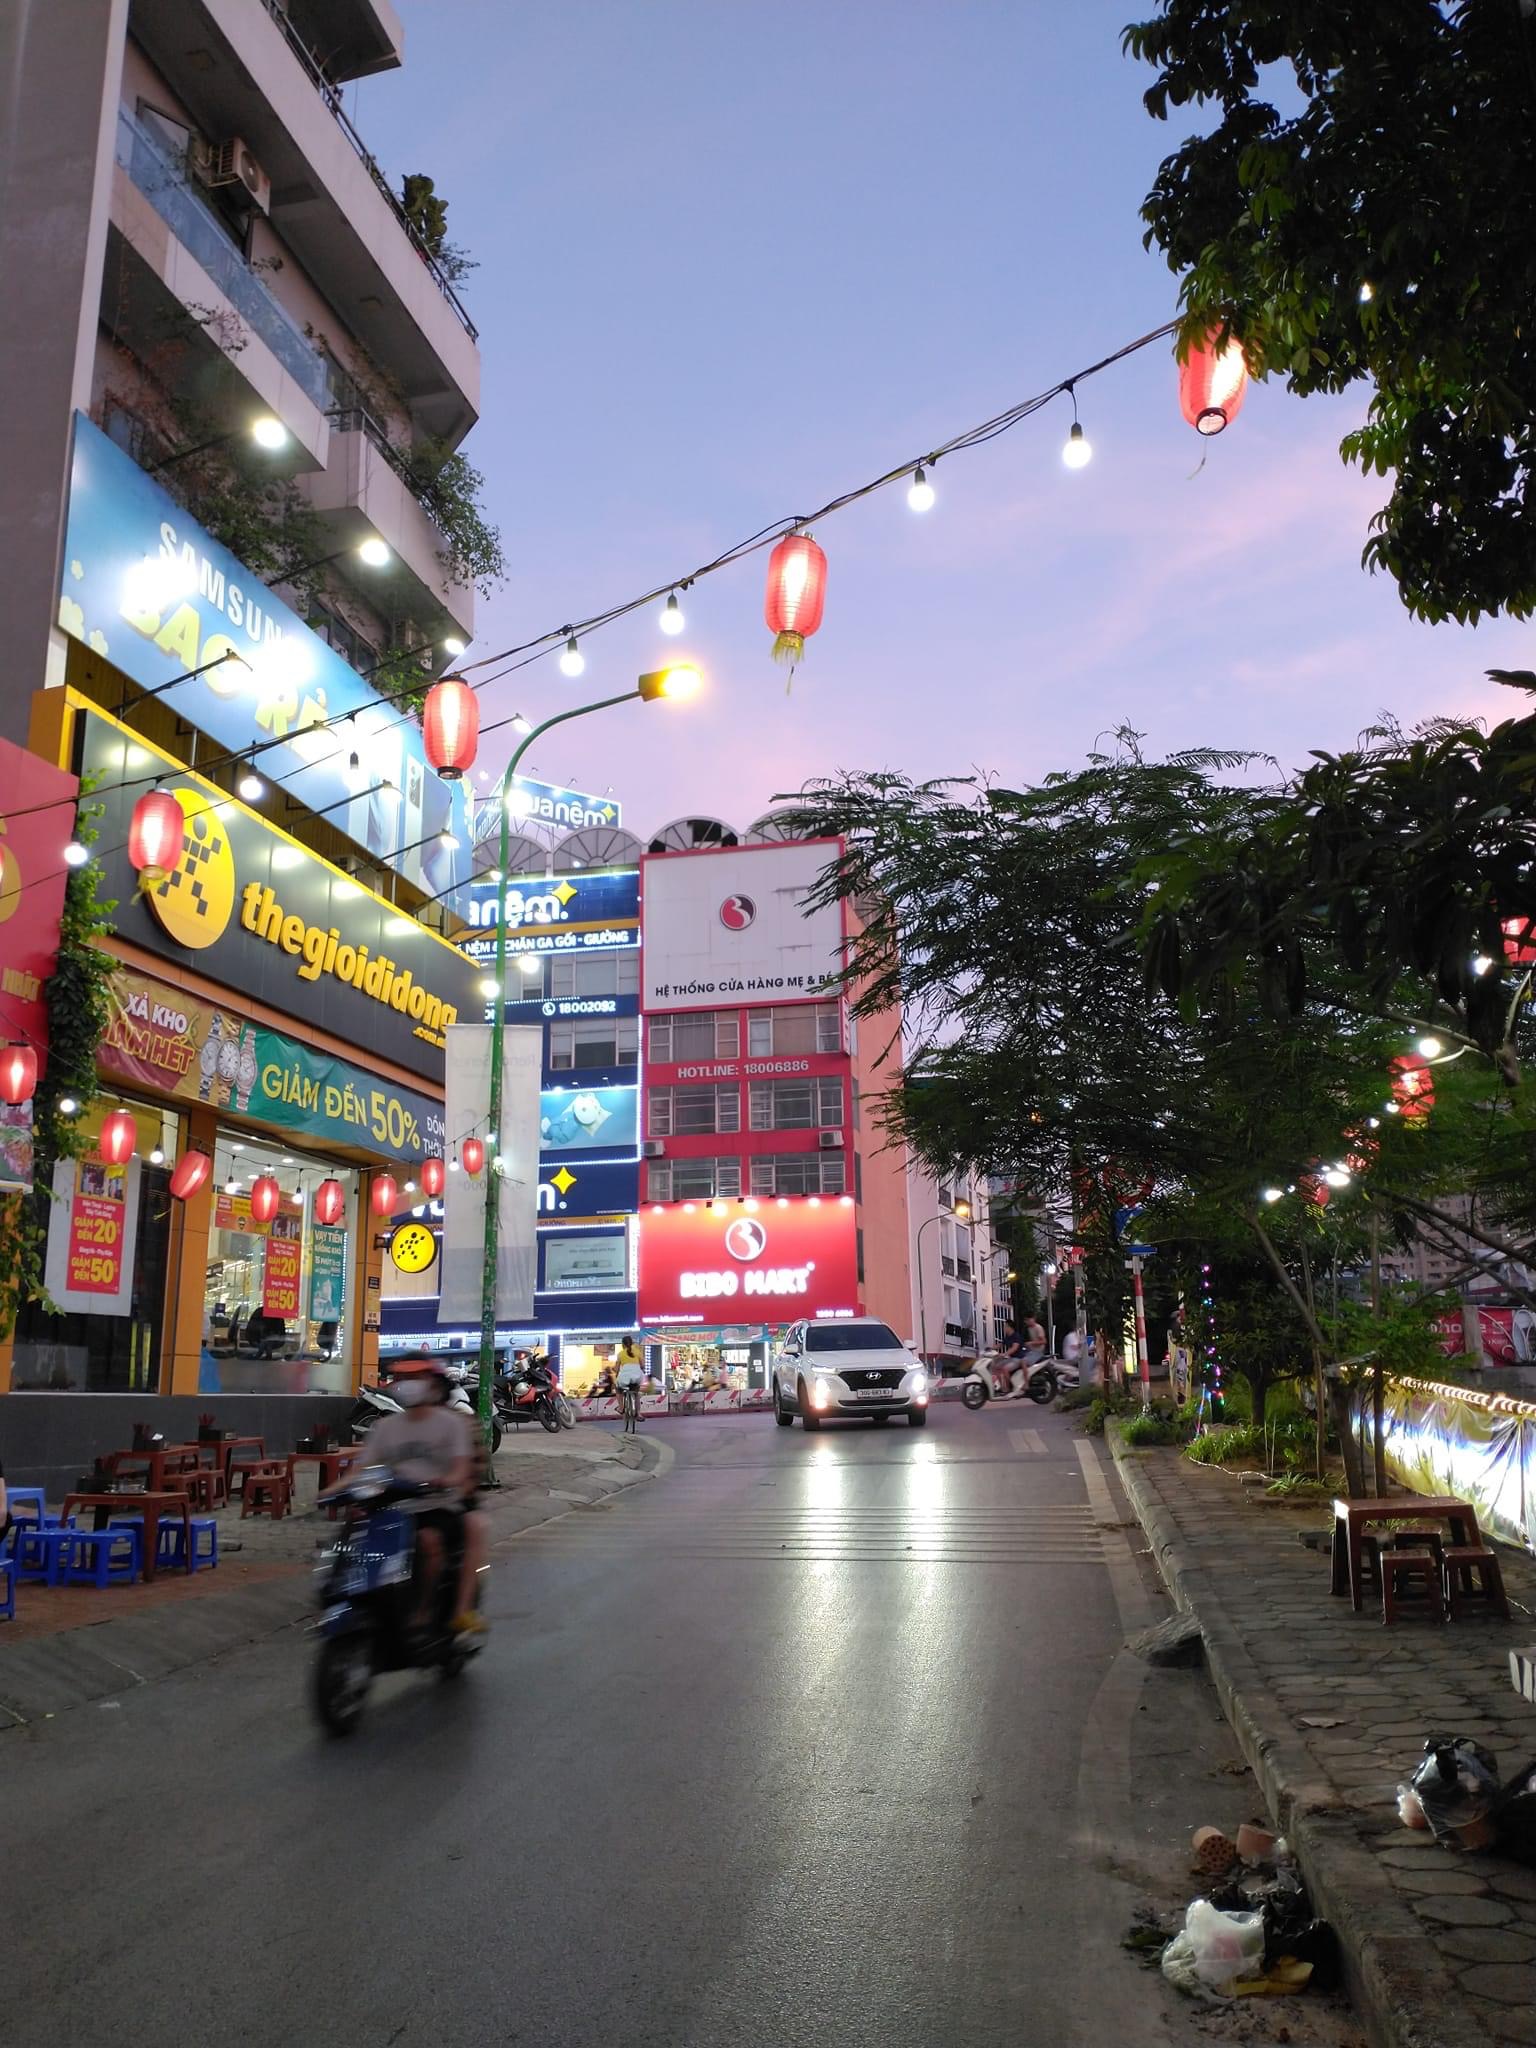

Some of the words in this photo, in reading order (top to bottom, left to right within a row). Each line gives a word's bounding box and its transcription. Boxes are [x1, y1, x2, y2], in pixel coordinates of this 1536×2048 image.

[157, 522, 296, 662] SAMSUN
[241, 881, 458, 1035] thegioididong
[537, 937, 554, 949] GA
[655, 985, 669, 998] HỆ
[673, 980, 715, 995] THỐNG
[719, 977, 744, 992] CỬA
[747, 975, 784, 990] HÀNG
[788, 974, 803, 988] MẸ
[807, 974, 815, 984] &
[125, 991, 148, 1020] XẢ
[152, 1004, 187, 1034] KHO
[559, 1001, 616, 1015] 18002092
[151, 1032, 195, 1075] HẾT
[678, 1065, 739, 1079] HOTLINE:
[744, 1060, 809, 1075] 18006886
[262, 1063, 320, 1113] GIẢM
[324, 1082, 368, 1128] ĐẾN
[371, 1090, 421, 1151] 50%
[744, 1268, 809, 1295] MART
